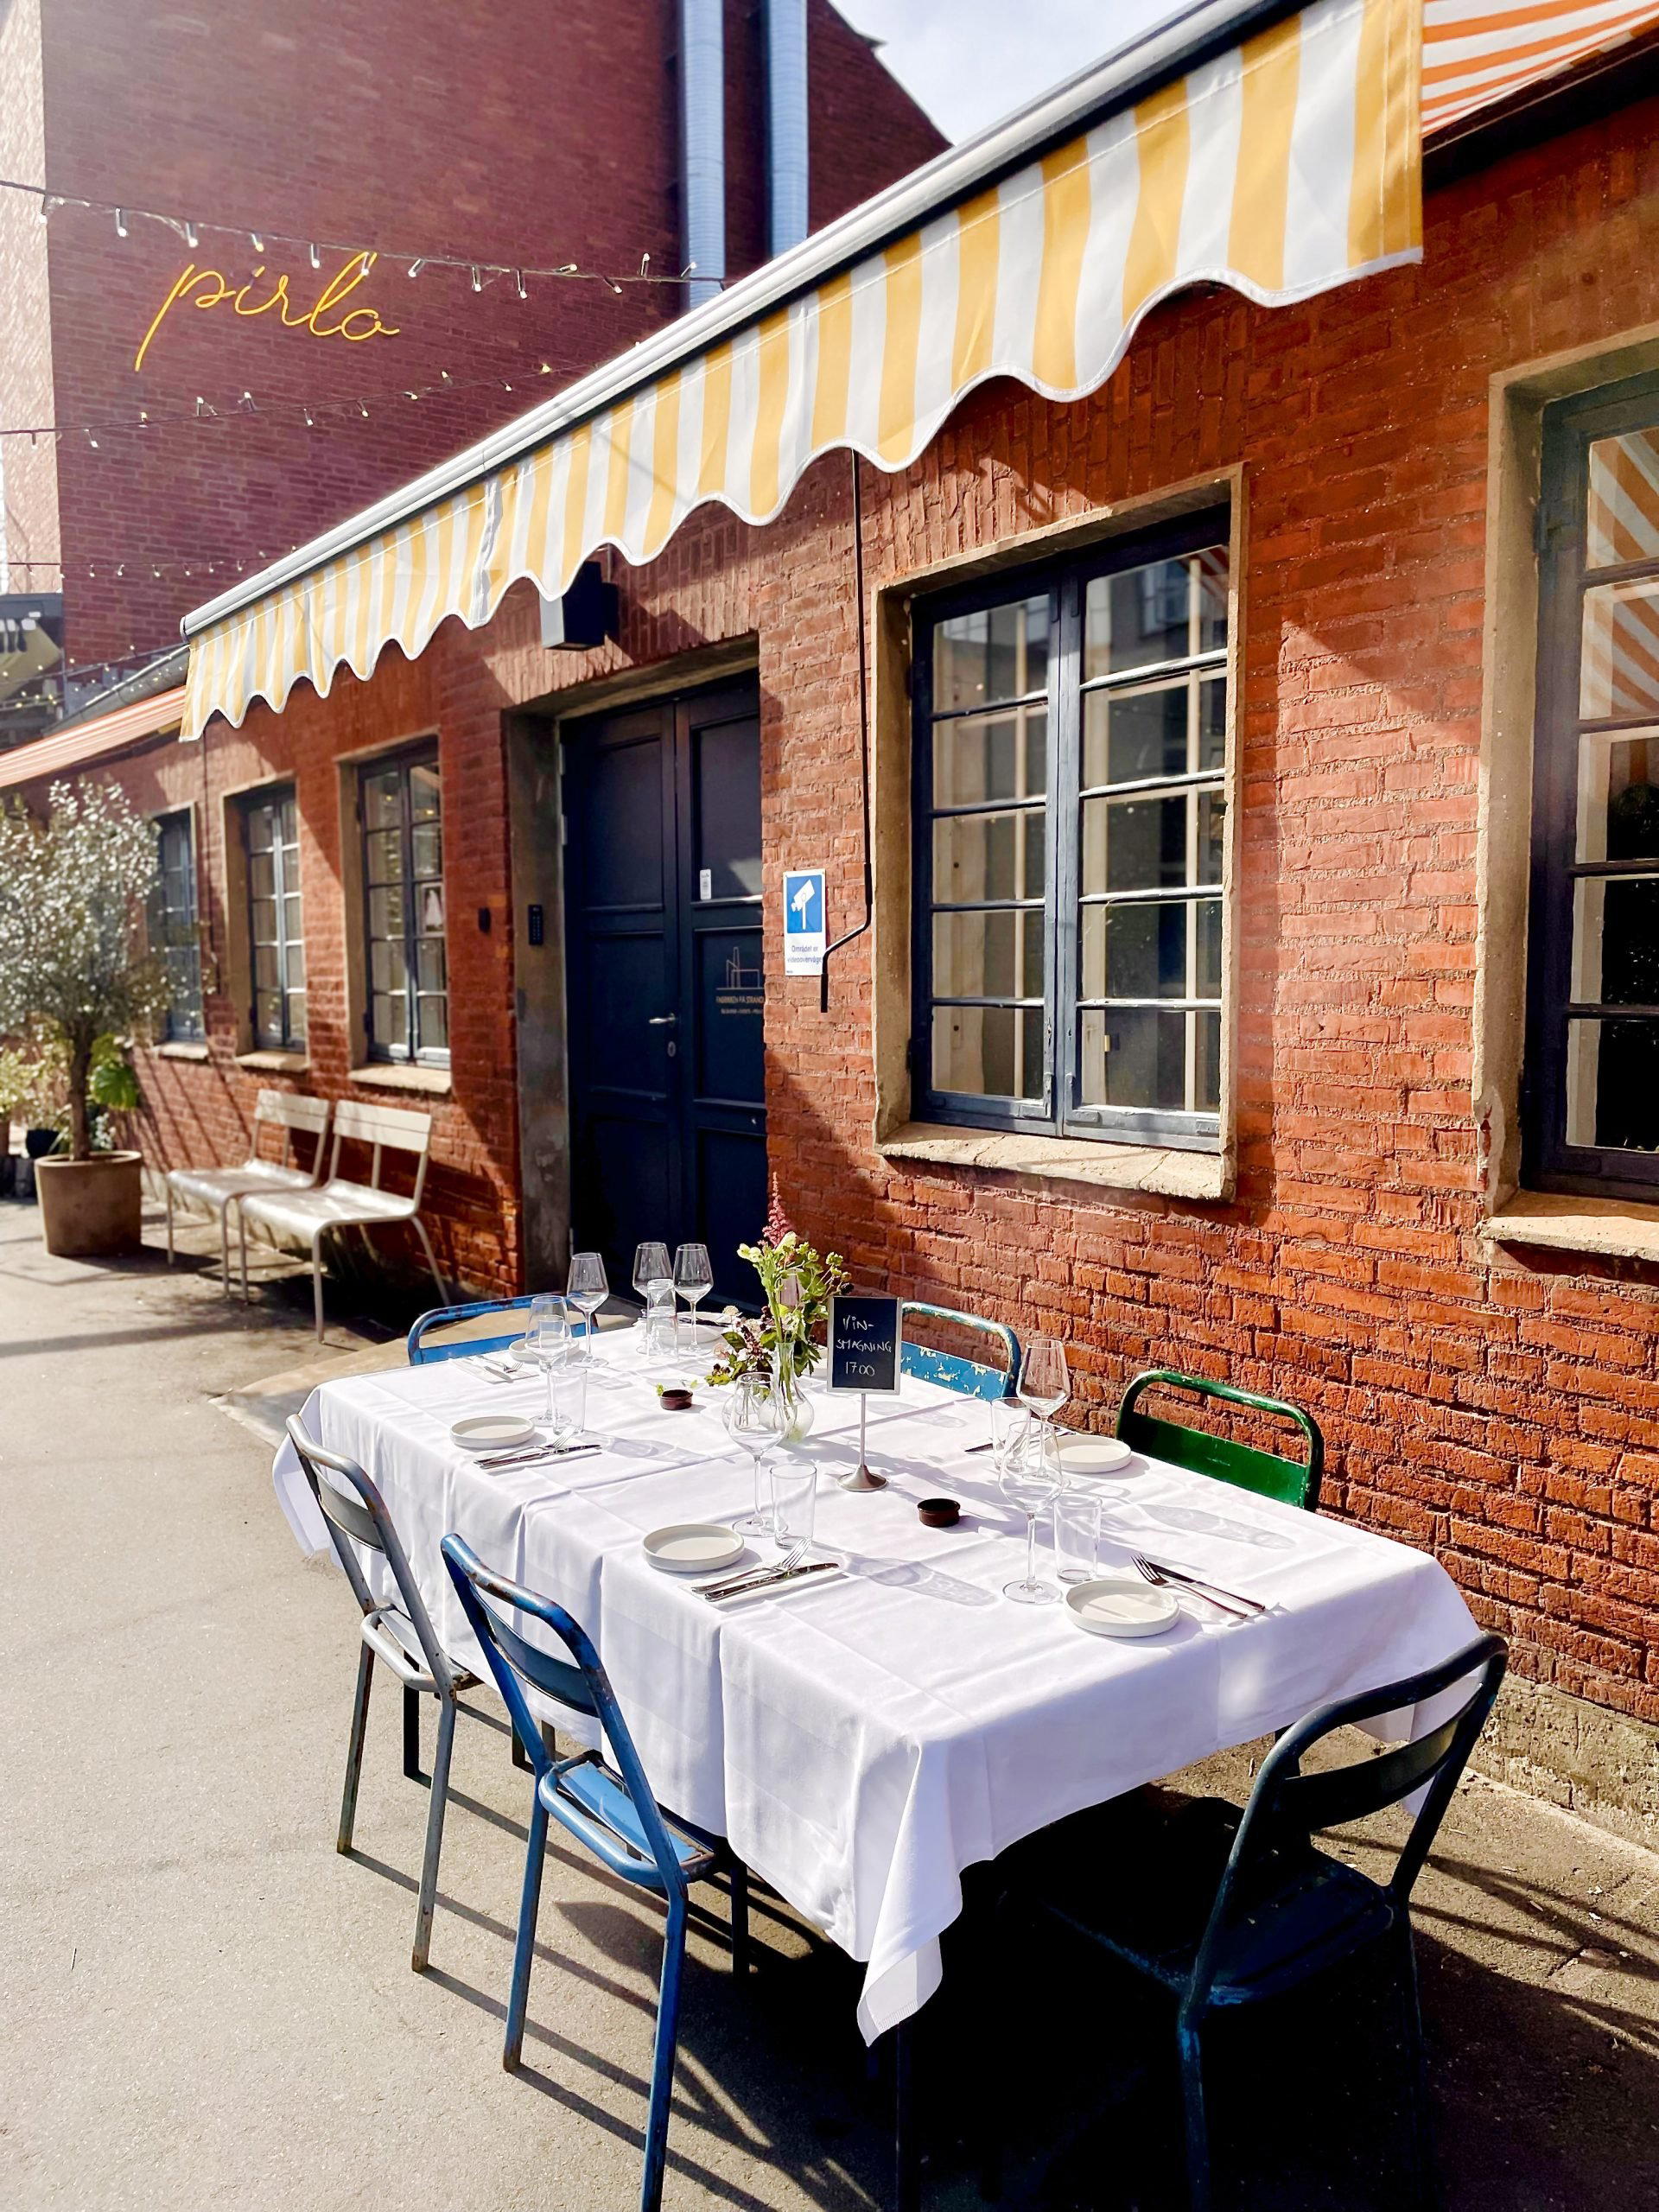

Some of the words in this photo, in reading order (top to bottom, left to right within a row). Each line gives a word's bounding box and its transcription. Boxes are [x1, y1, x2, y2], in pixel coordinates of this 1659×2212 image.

[135, 251, 400, 372] pirlo
[791, 944, 812, 953] Området
[787, 956, 823, 965] videoovervåge
[836, 1338, 892, 1353] SMAGNING
[845, 1361, 875, 1376] 1700
